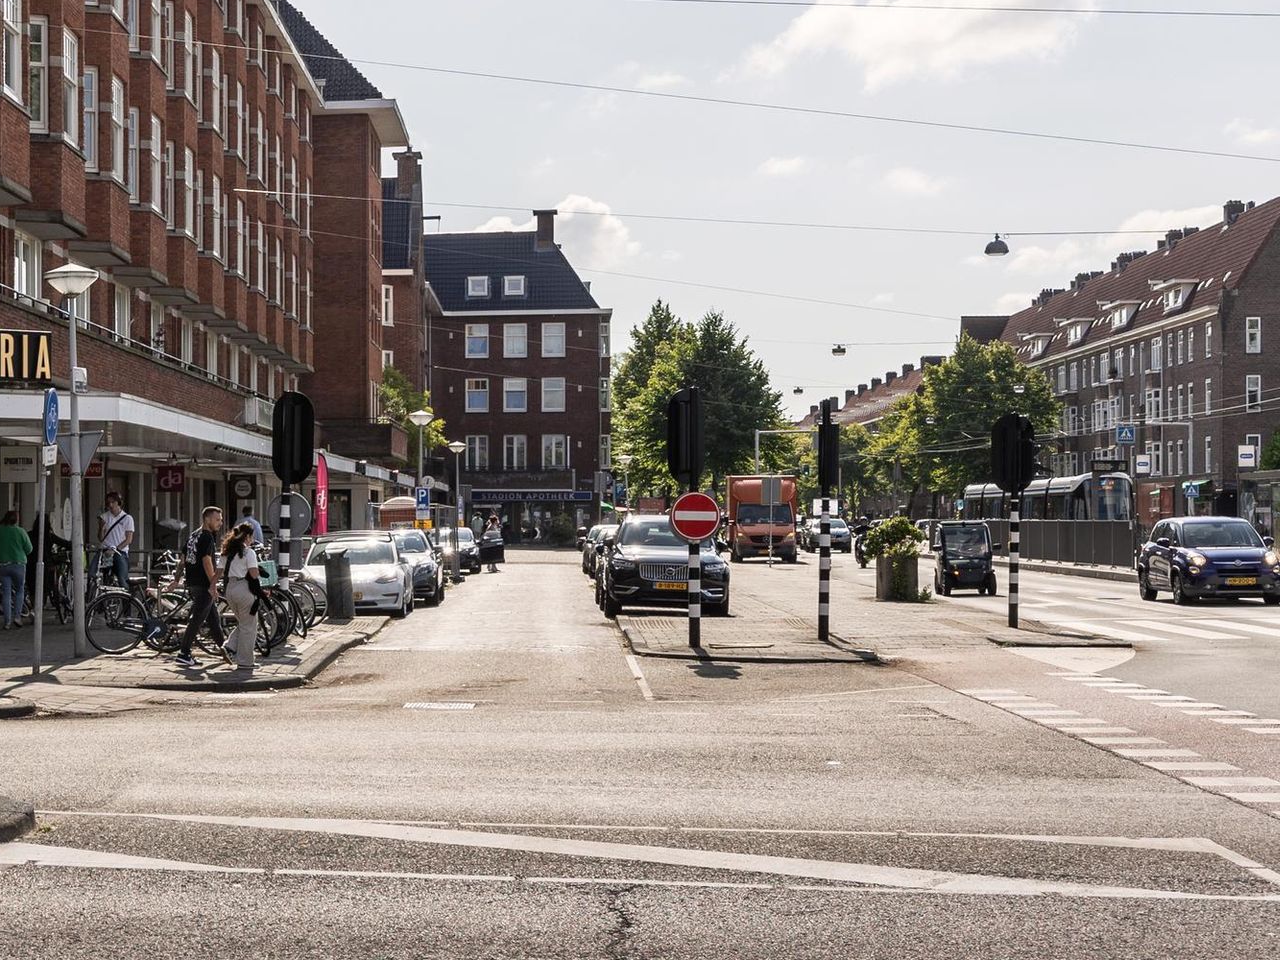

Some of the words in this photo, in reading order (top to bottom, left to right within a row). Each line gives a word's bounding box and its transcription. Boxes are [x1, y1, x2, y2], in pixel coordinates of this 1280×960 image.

[160, 469, 183, 489] da
[419, 489, 426, 502] P
[481, 492, 522, 500] STADION
[526, 492, 575, 500] APOTHEEK
